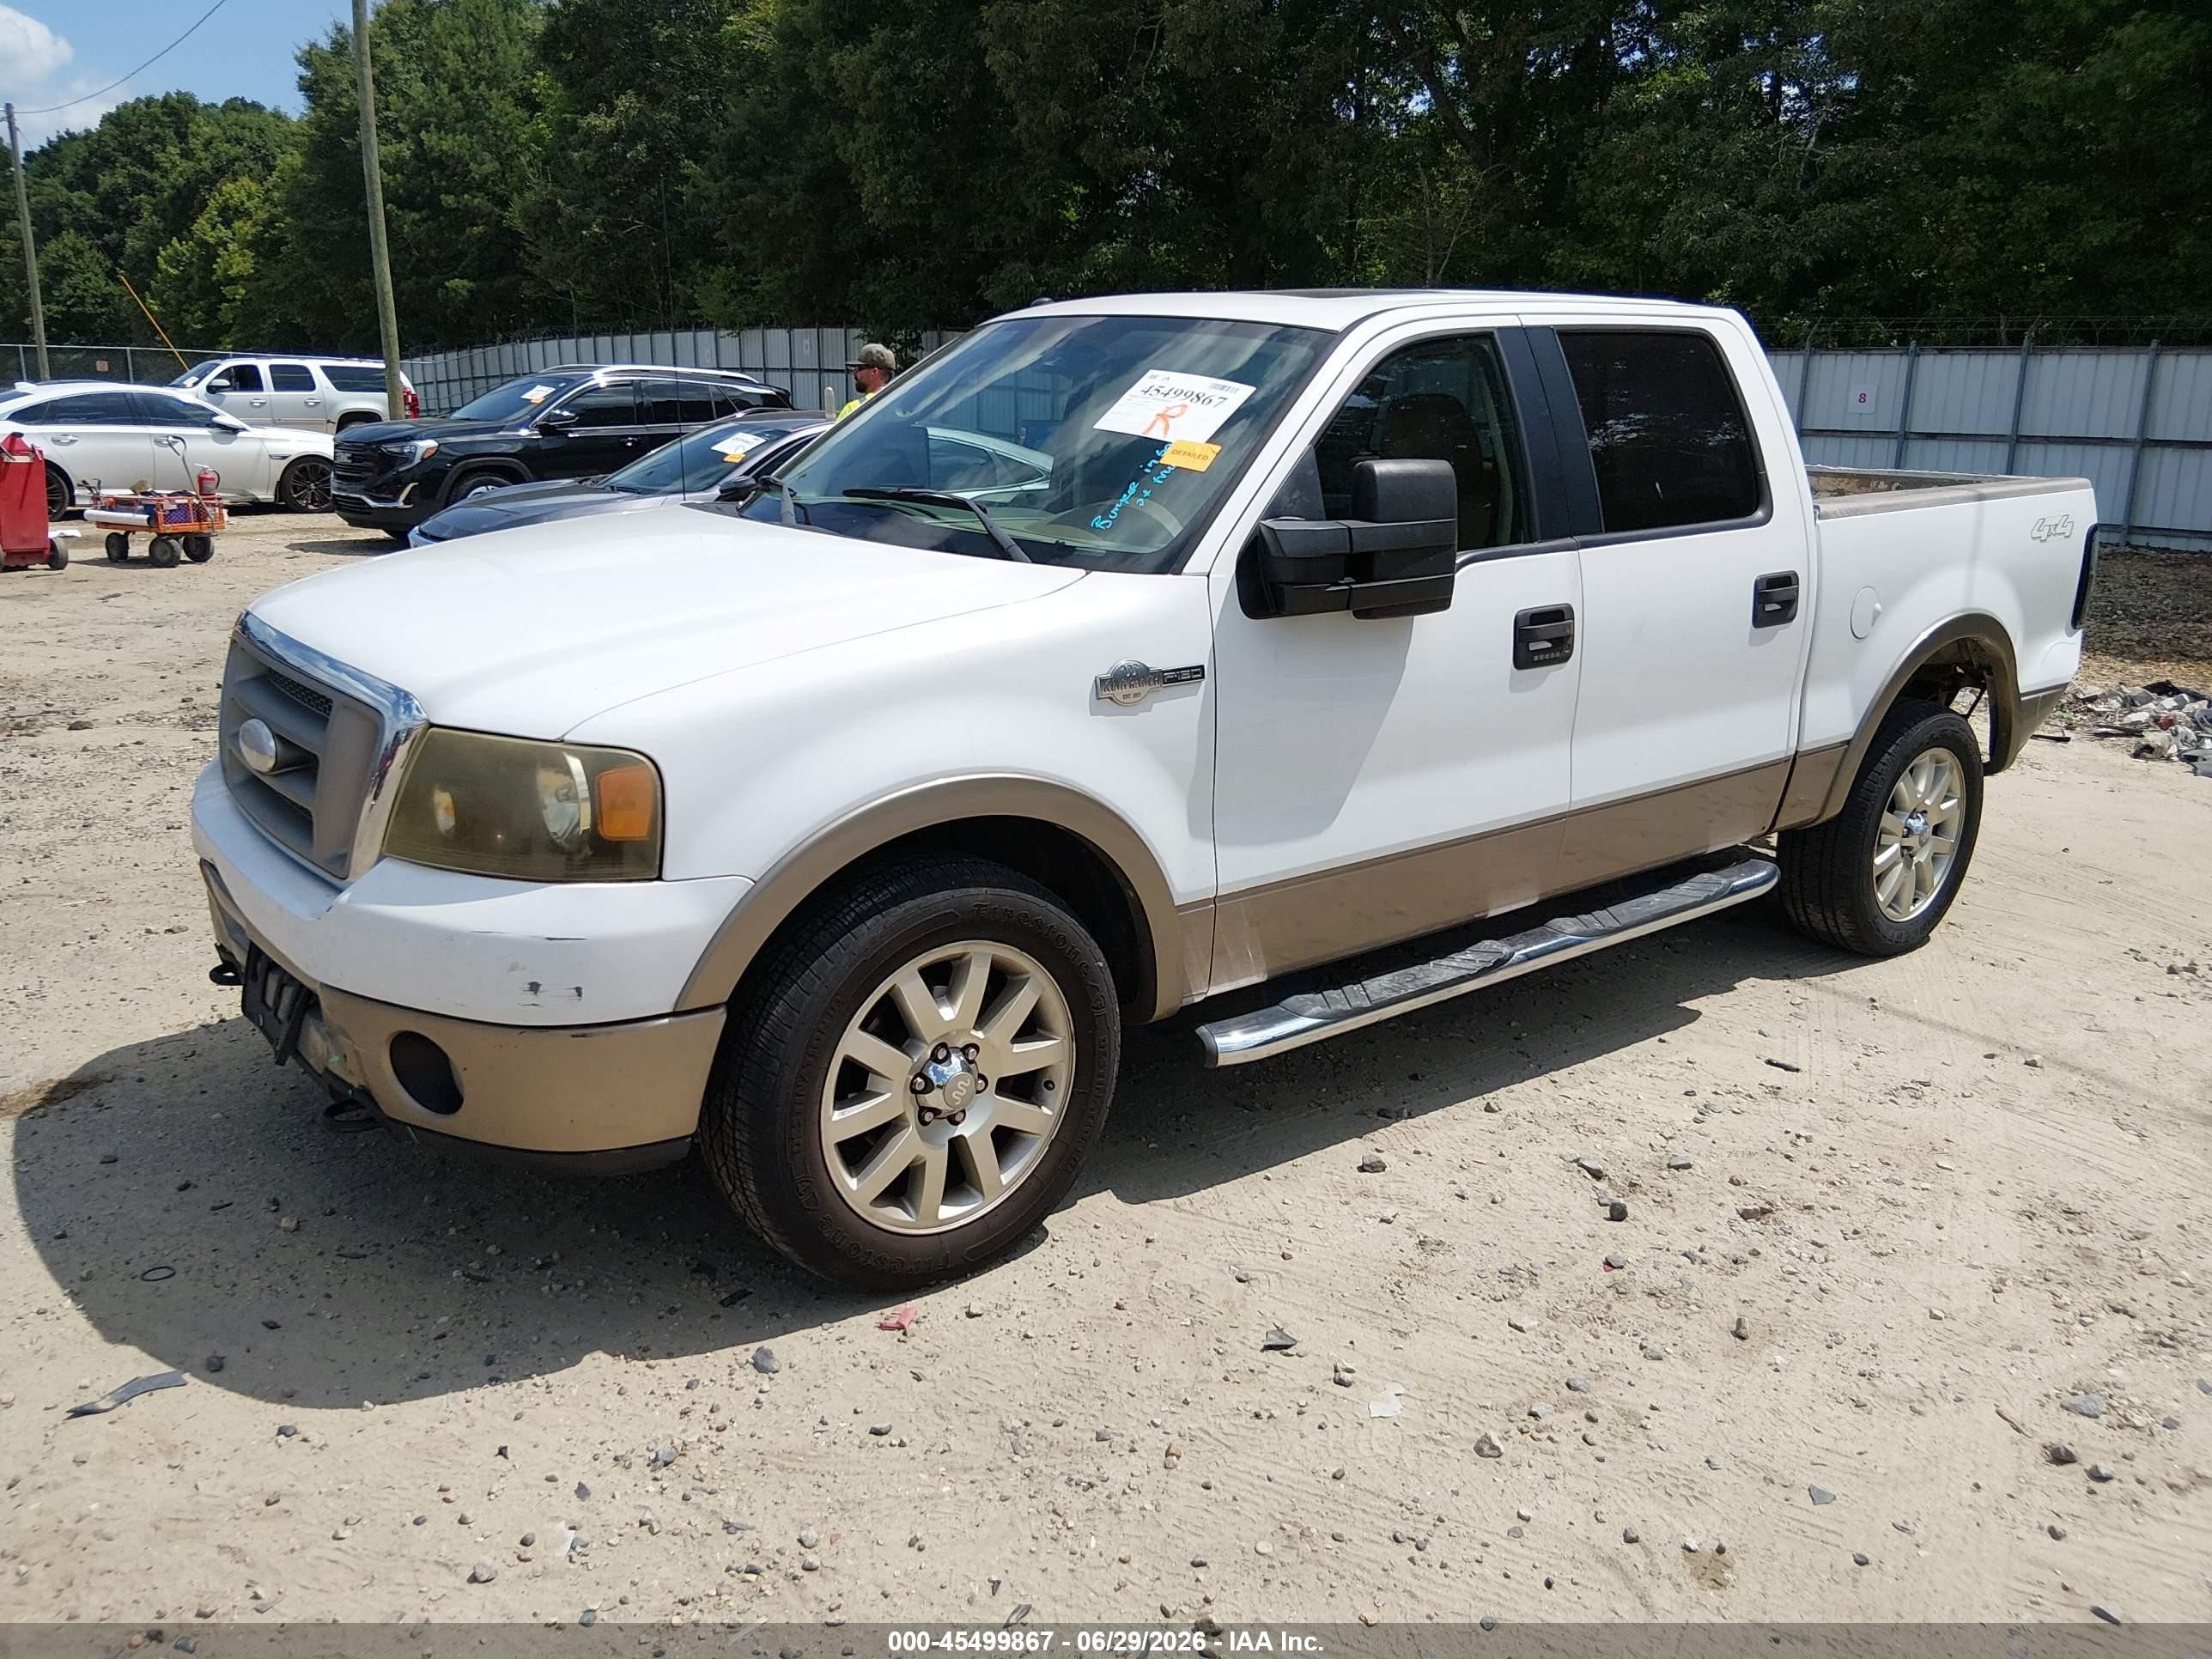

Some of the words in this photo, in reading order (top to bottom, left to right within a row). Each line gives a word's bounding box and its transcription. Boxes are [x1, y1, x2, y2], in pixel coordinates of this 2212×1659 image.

[1140, 385, 1229, 408] 45499867
[1858, 392, 1867, 404] 8
[1141, 404, 1188, 439] R
[1170, 448, 1209, 461] DETAILED
[2030, 514, 2075, 543] 4x4
[1128, 672, 1160, 690] RANCH
[969, 902, 1091, 977] Firestone
[817, 1213, 954, 1275] Firestone
